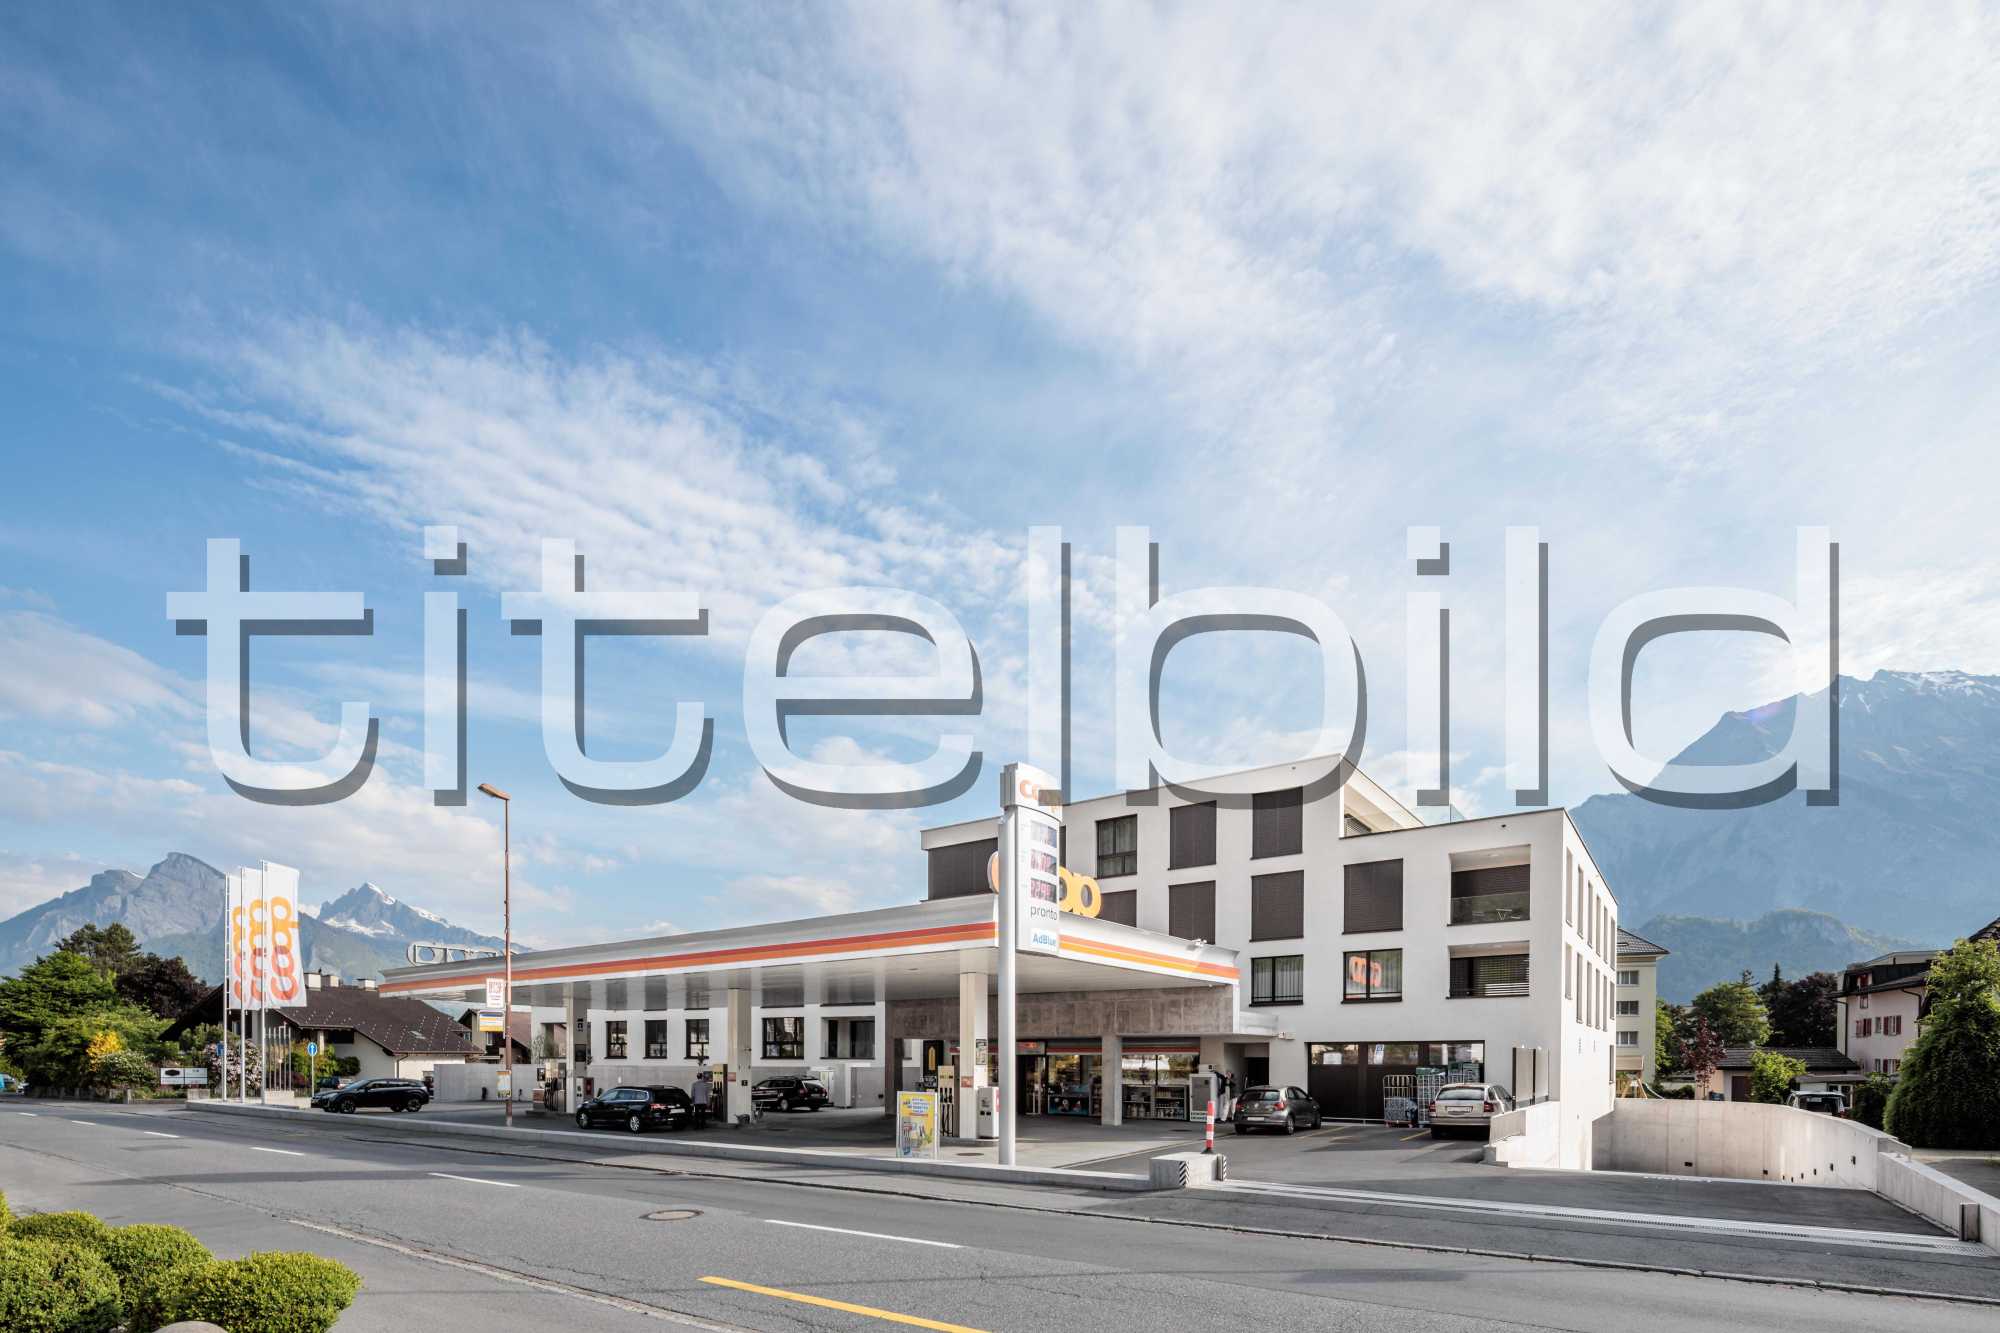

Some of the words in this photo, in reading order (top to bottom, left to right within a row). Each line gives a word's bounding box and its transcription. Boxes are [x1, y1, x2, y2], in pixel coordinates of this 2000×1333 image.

[1030, 905, 1058, 921] pronto
[1032, 932, 1058, 947] AdBlue
[270, 895, 300, 1001] coop
